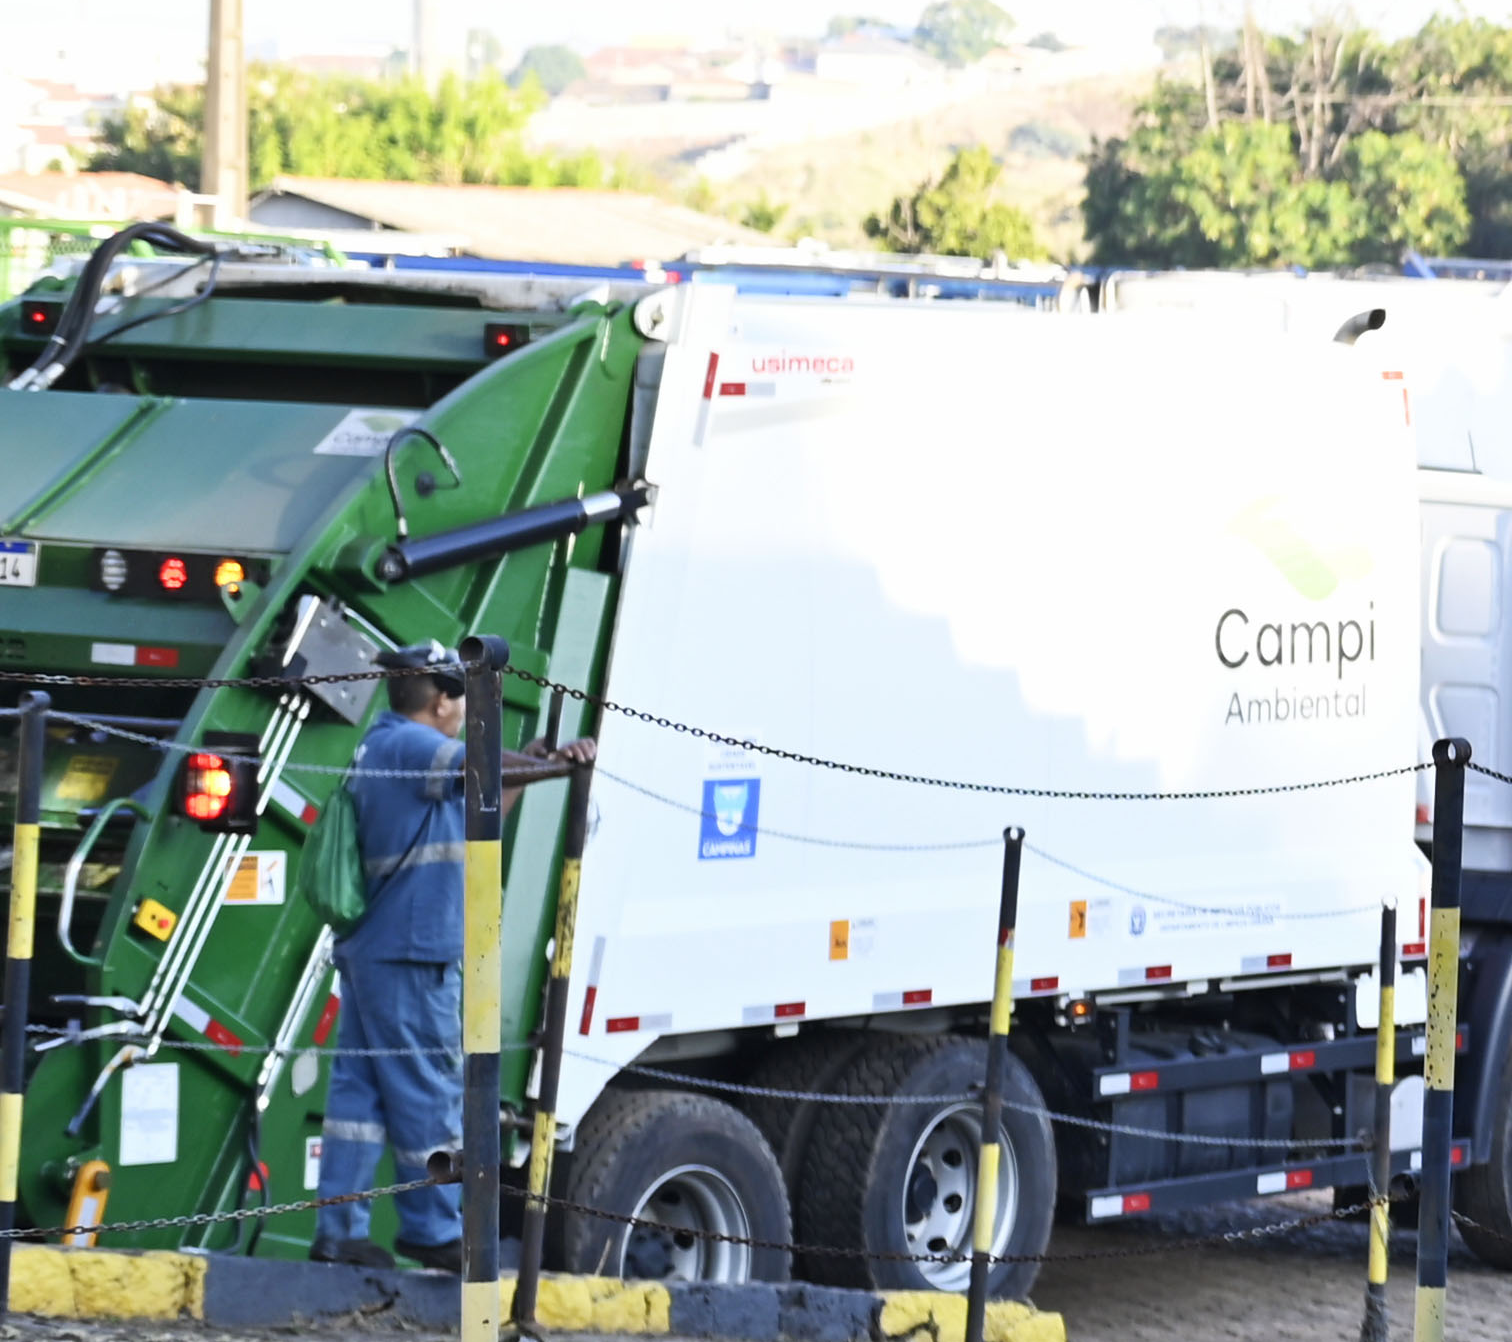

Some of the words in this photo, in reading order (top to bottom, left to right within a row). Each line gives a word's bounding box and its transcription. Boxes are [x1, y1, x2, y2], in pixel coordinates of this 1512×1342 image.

[752, 348, 854, 373] usimeca
[1215, 600, 1375, 681] Campi
[1225, 683, 1367, 726] Ambiental
